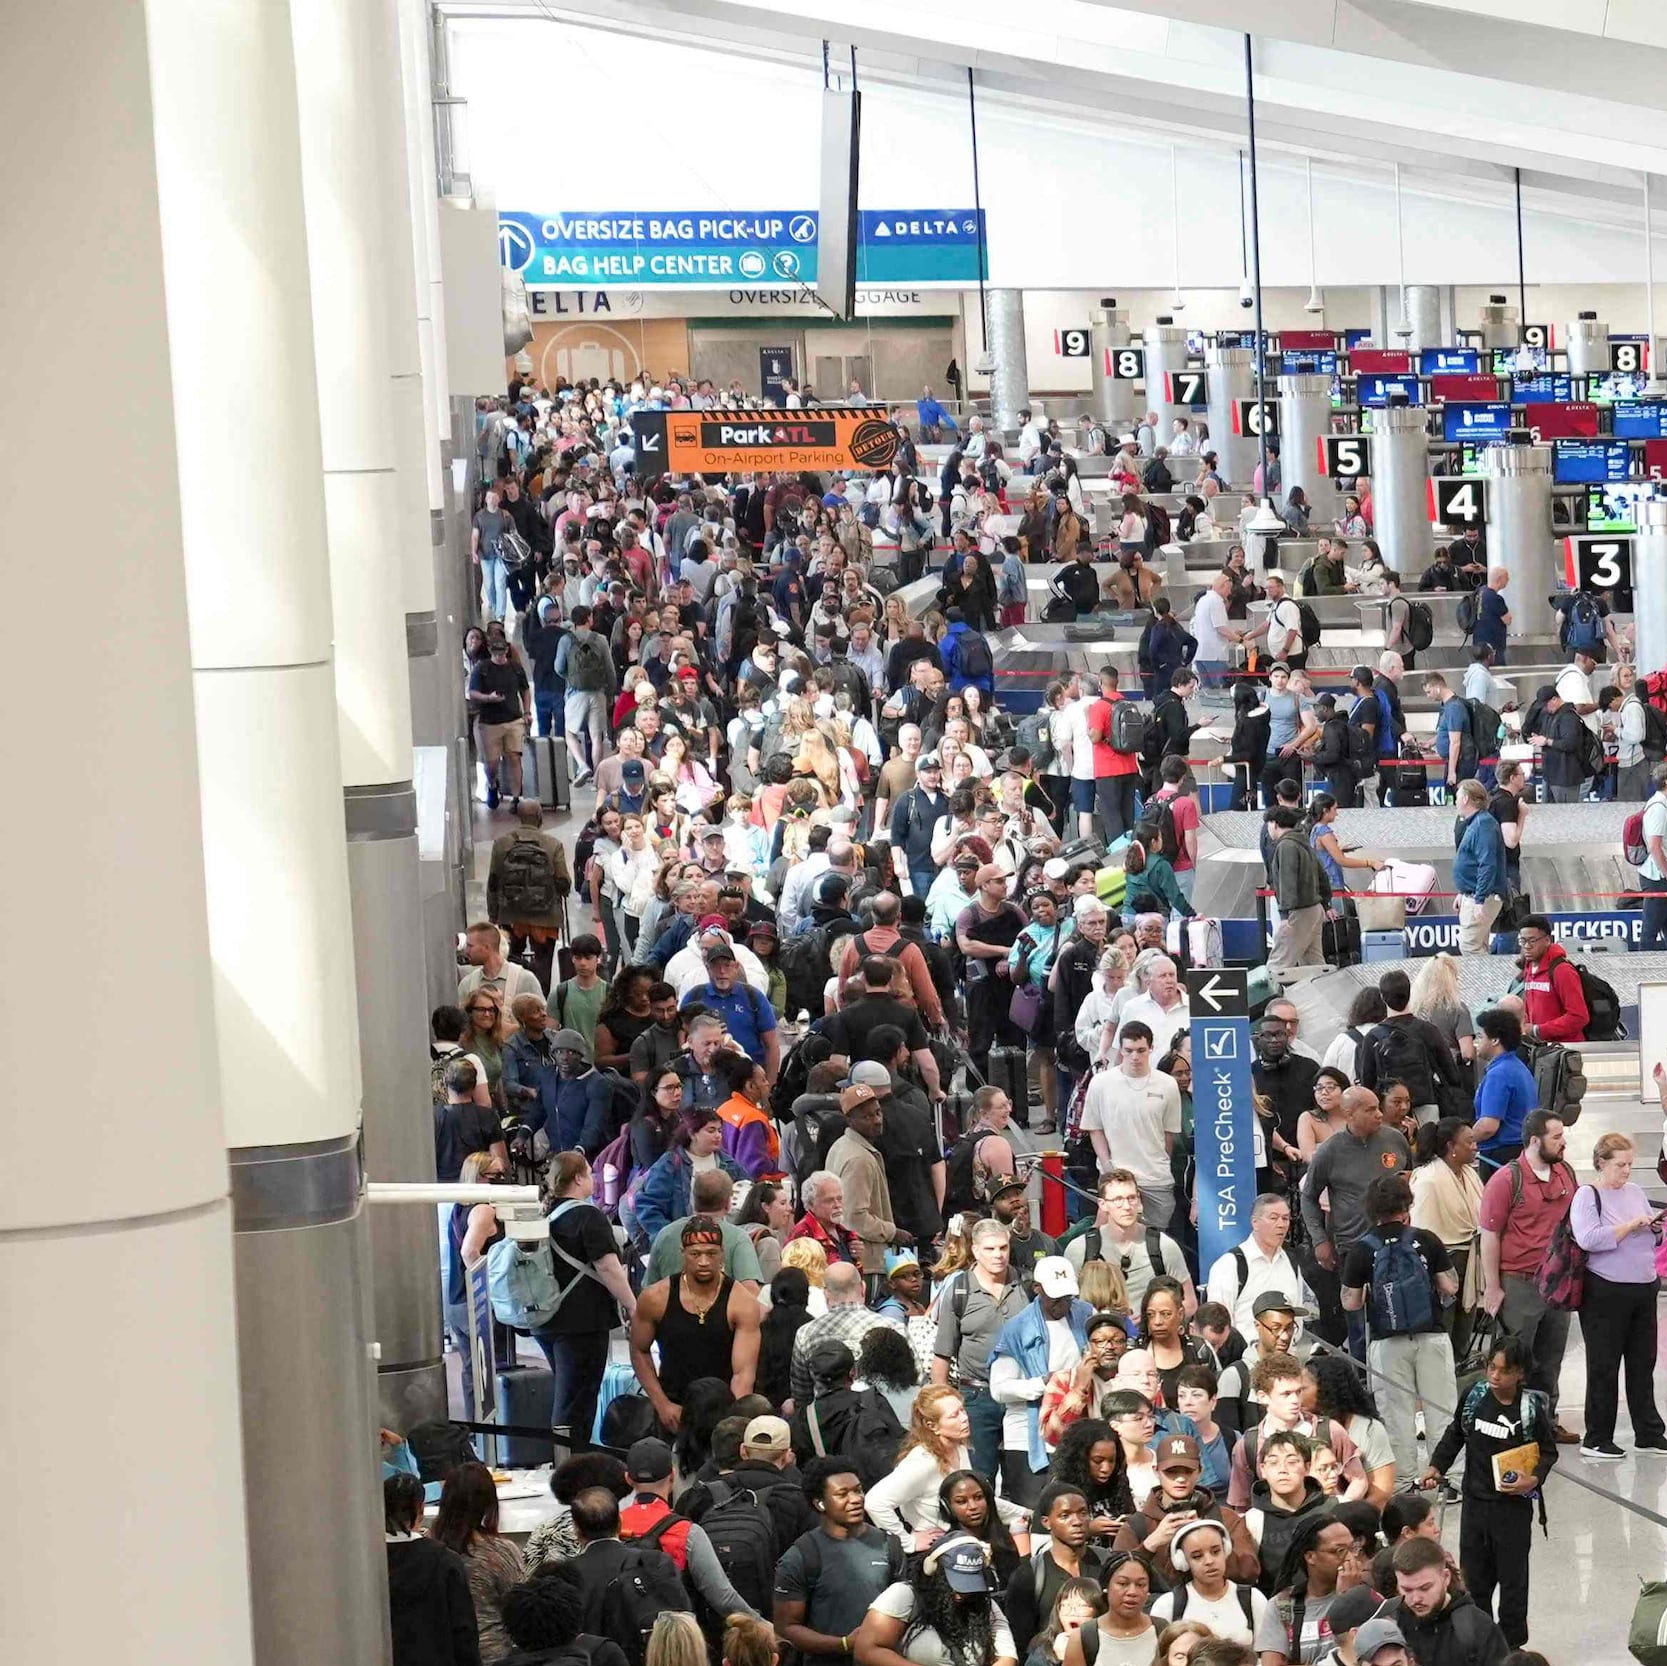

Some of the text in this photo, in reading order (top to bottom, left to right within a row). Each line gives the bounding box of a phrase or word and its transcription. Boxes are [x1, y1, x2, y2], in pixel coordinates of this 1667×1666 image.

[542, 219, 782, 240] OVERSIZE BAG PICK-UP
[895, 220, 958, 235] DELTA
[544, 255, 733, 275] BAG HELP CENTER
[531, 291, 610, 313] ELTA
[1067, 332, 1084, 355] 9
[1526, 328, 1543, 348] 9
[1119, 352, 1138, 377] 8
[1617, 346, 1636, 370] 8
[1180, 375, 1199, 402] 7
[1249, 405, 1271, 435] 6
[720, 425, 816, 444] ParkATL
[854, 429, 897, 457] DETOUR
[704, 451, 844, 466] On-Airport Parking
[1338, 441, 1360, 474] 5
[1650, 465, 1662, 480] 5
[1447, 485, 1477, 520] 4
[1591, 544, 1620, 586] 3
[1218, 1185, 1237, 1231] TSA
[1054, 1270, 1067, 1280] M
